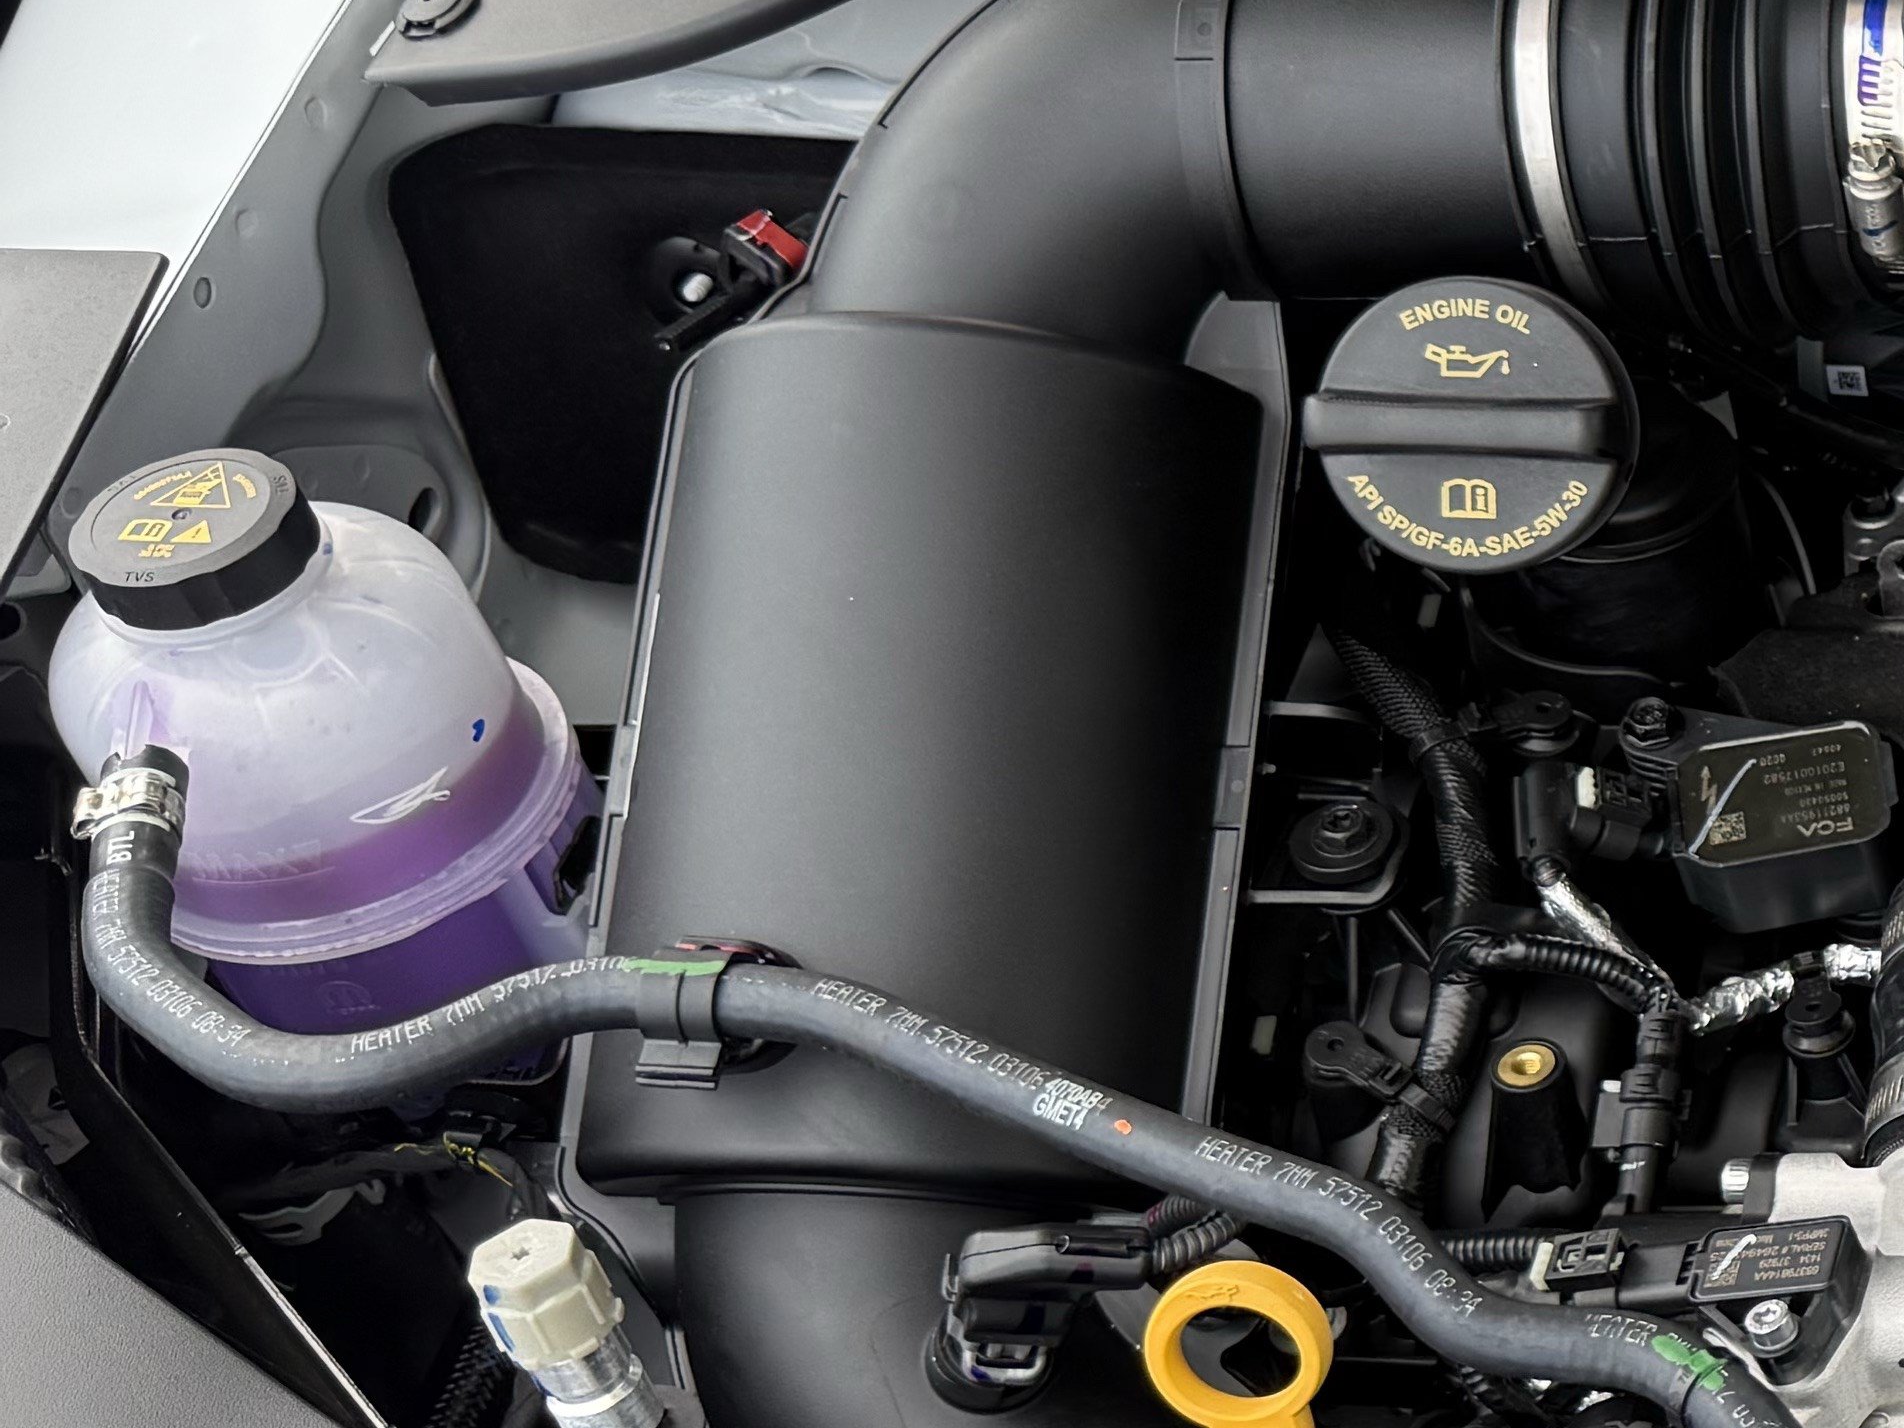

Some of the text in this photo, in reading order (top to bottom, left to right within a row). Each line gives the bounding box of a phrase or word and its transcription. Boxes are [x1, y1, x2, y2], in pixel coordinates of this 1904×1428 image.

[1399, 298, 1532, 335] ENGINE OIL
[1347, 474, 1385, 510] API
[124, 571, 155, 583] TVS
[1796, 817, 1855, 838] FCA
[106, 830, 135, 865] BTL
[108, 944, 160, 986] 57512
[146, 979, 203, 1019] 03106
[350, 1014, 432, 1054] HEATER
[811, 978, 888, 1017] HEATER
[925, 1025, 989, 1064] 57512
[1032, 1093, 1091, 1130] GMET4
[1195, 1136, 1273, 1175] HEATER
[1273, 1161, 1319, 1189] 7MM
[1318, 1175, 1383, 1221] 57512
[1378, 1215, 1434, 1272] 03106
